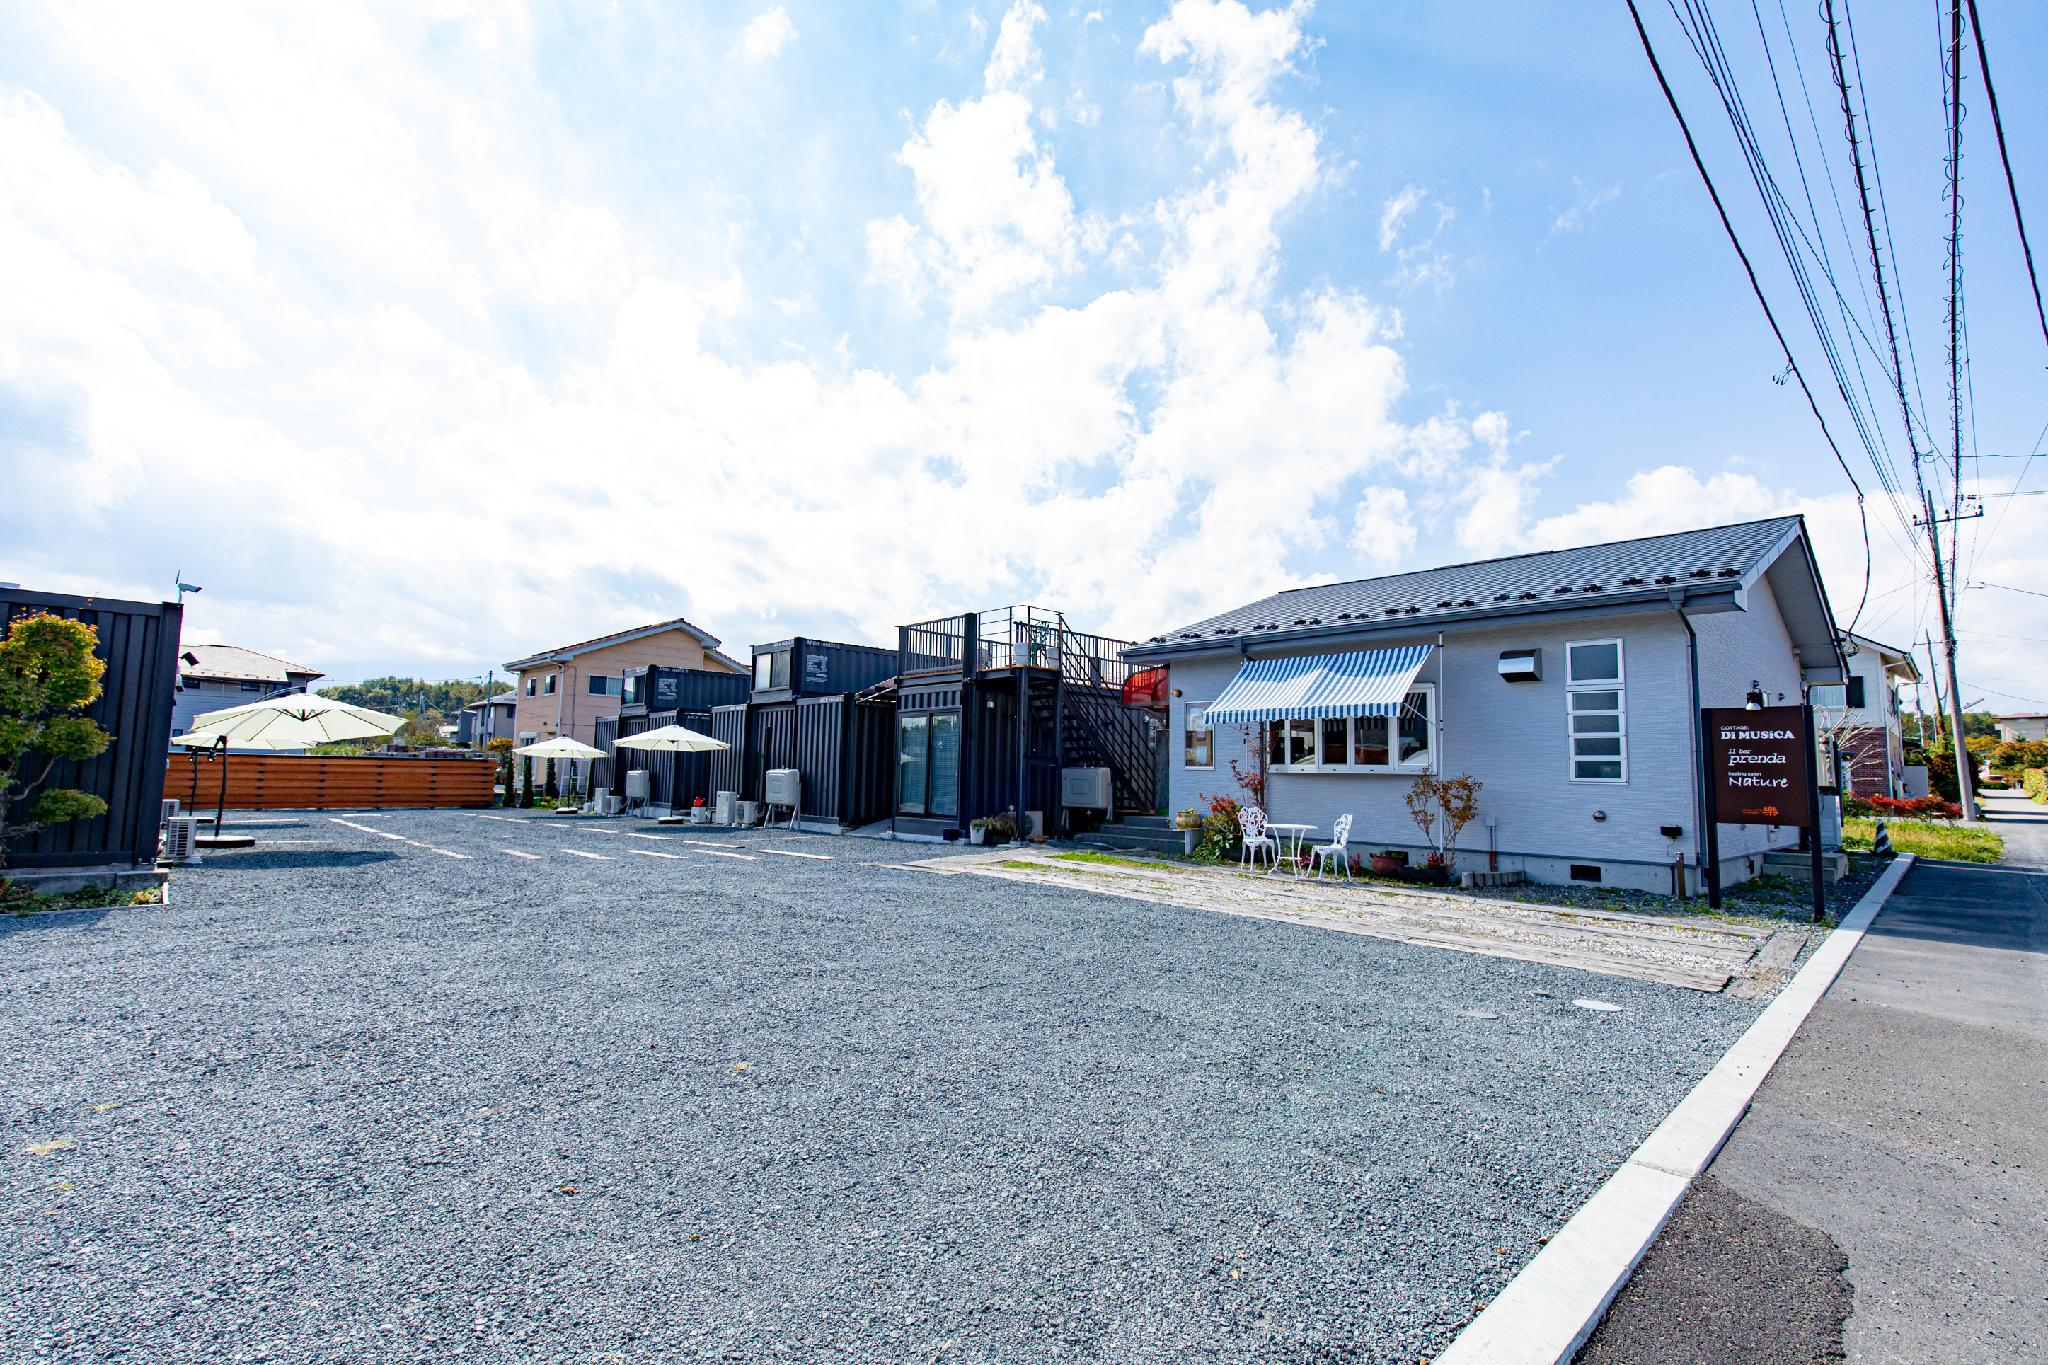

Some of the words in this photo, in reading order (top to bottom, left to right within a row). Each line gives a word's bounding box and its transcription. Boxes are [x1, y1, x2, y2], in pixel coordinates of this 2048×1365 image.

[1720, 732, 1736, 740] Di
[1738, 730, 1796, 740] MUSiCA
[1728, 753, 1786, 766] prenda
[1729, 776, 1789, 788] Nature
